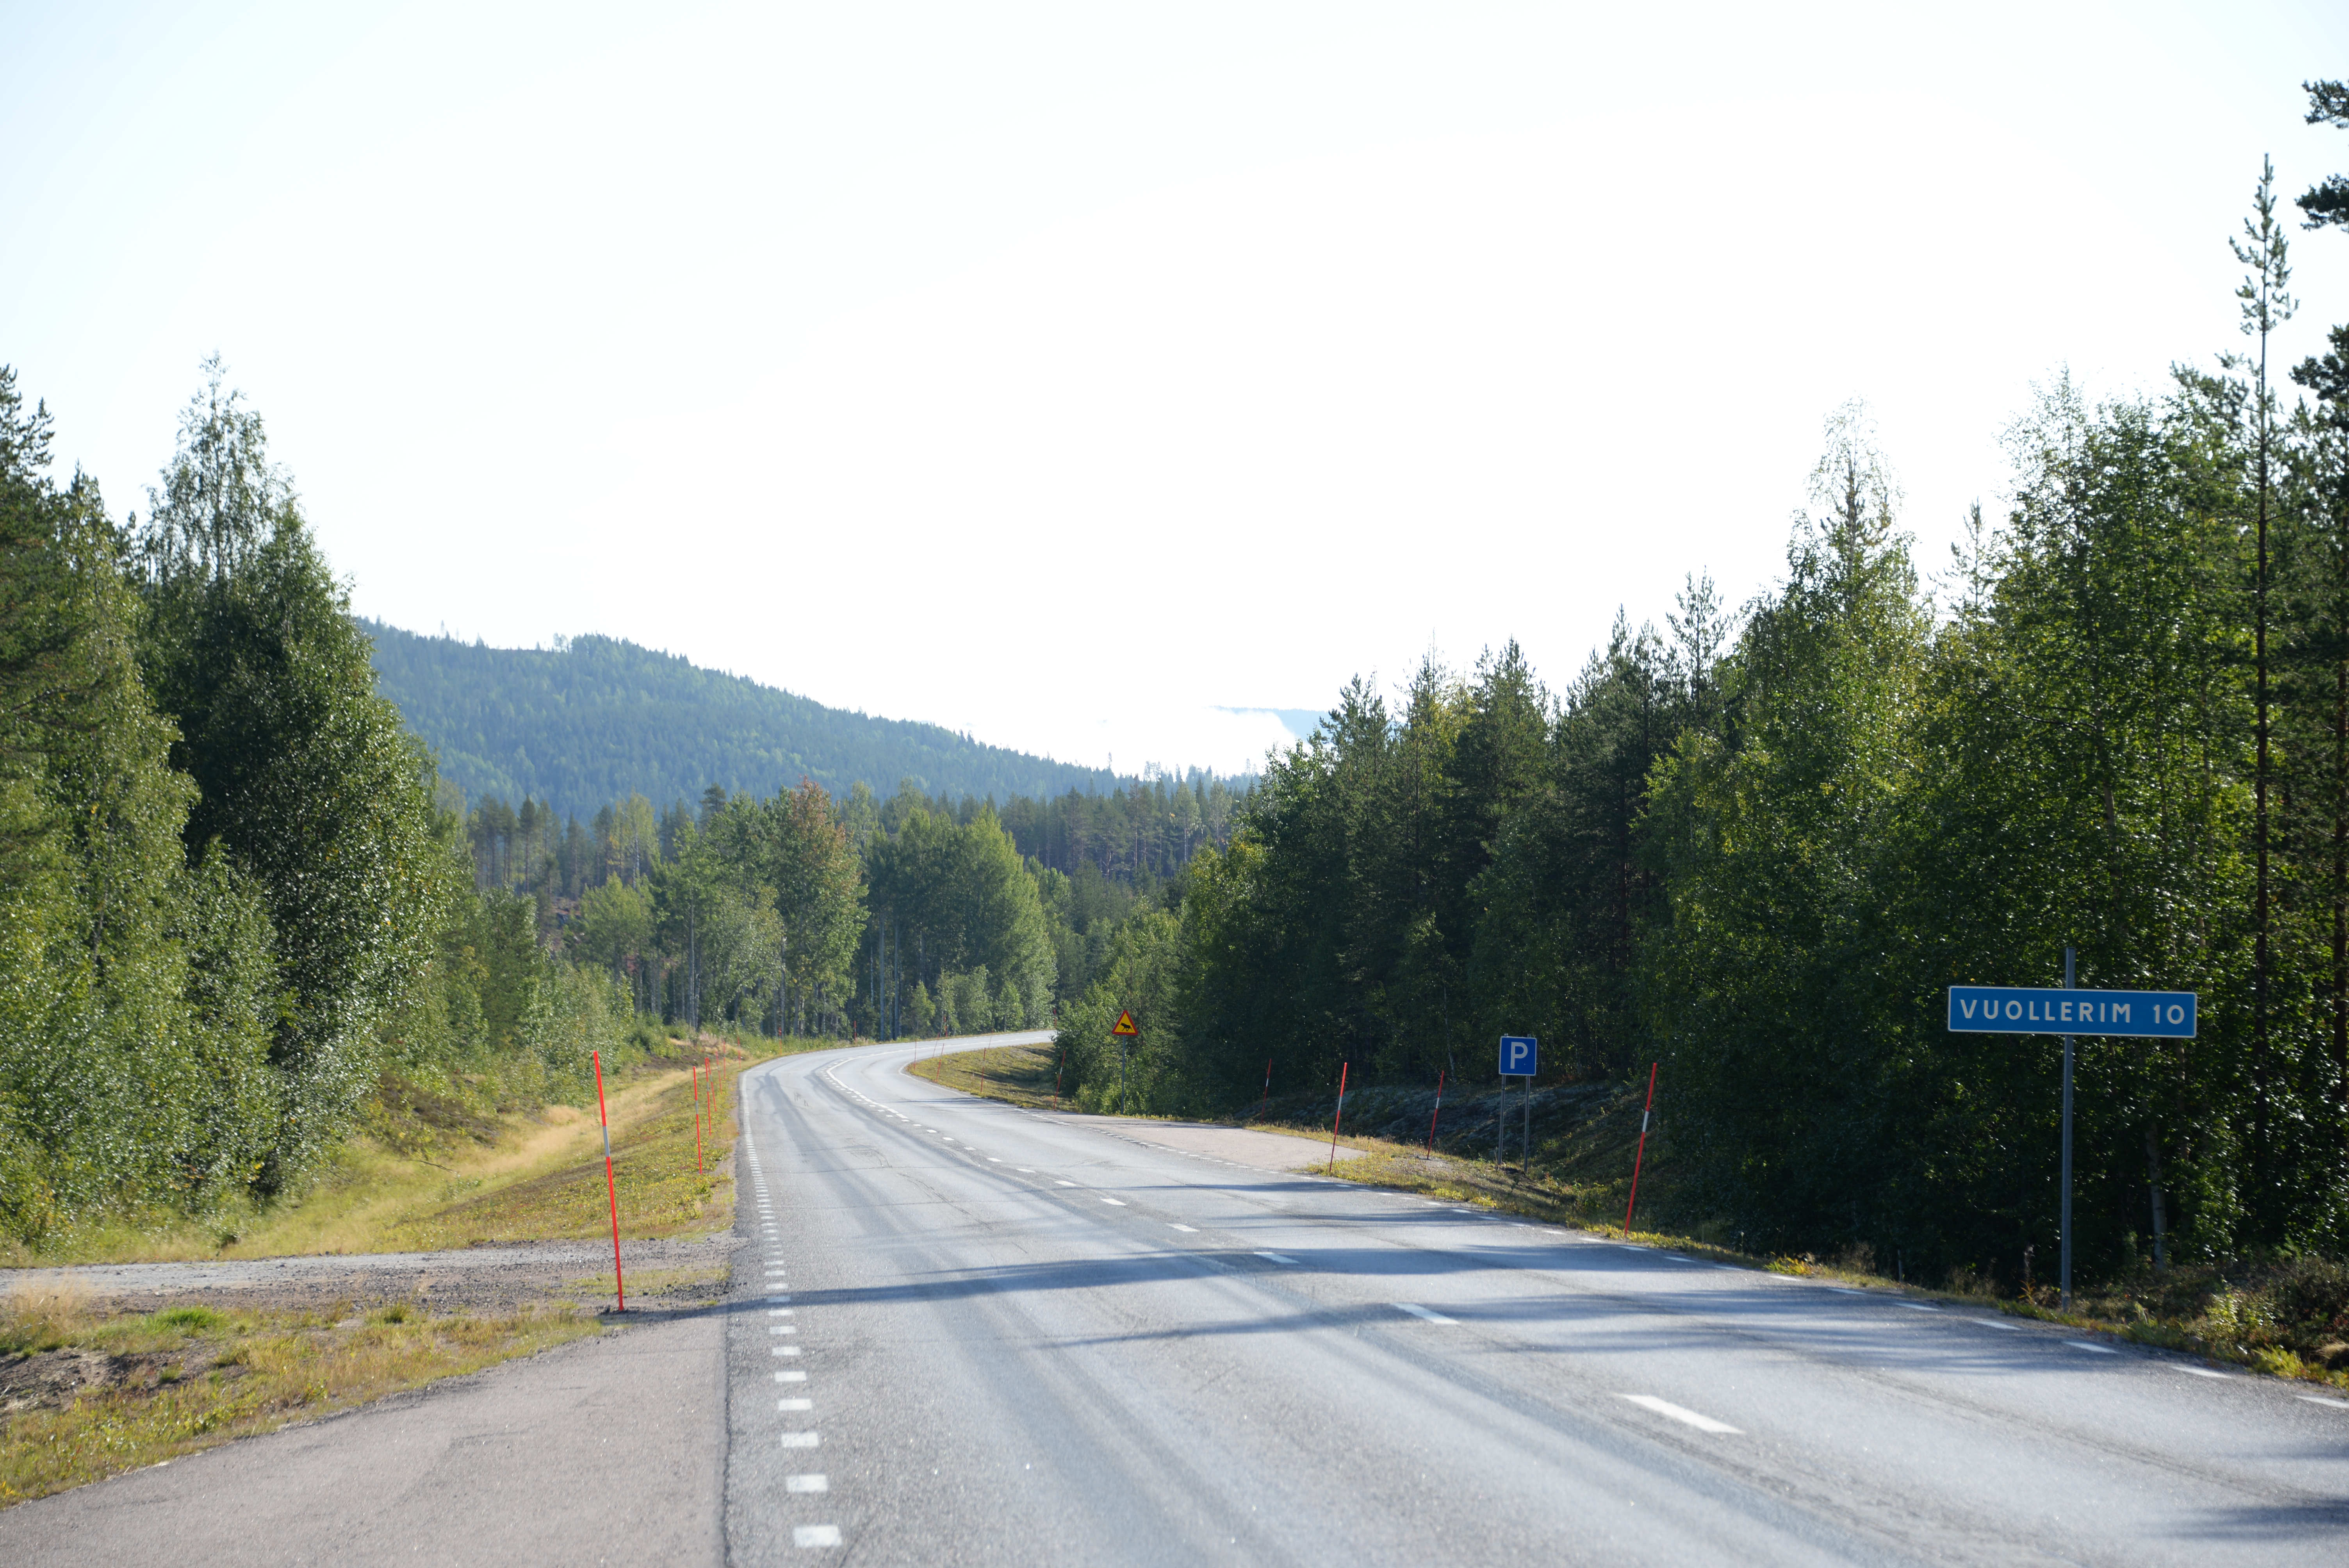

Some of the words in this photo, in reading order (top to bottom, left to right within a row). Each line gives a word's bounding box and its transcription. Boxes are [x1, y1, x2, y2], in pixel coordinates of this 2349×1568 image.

[1960, 999, 2130, 1023] VUOLLERIM
[2153, 1004, 2185, 1025] 10
[1510, 1041, 1528, 1069] P
